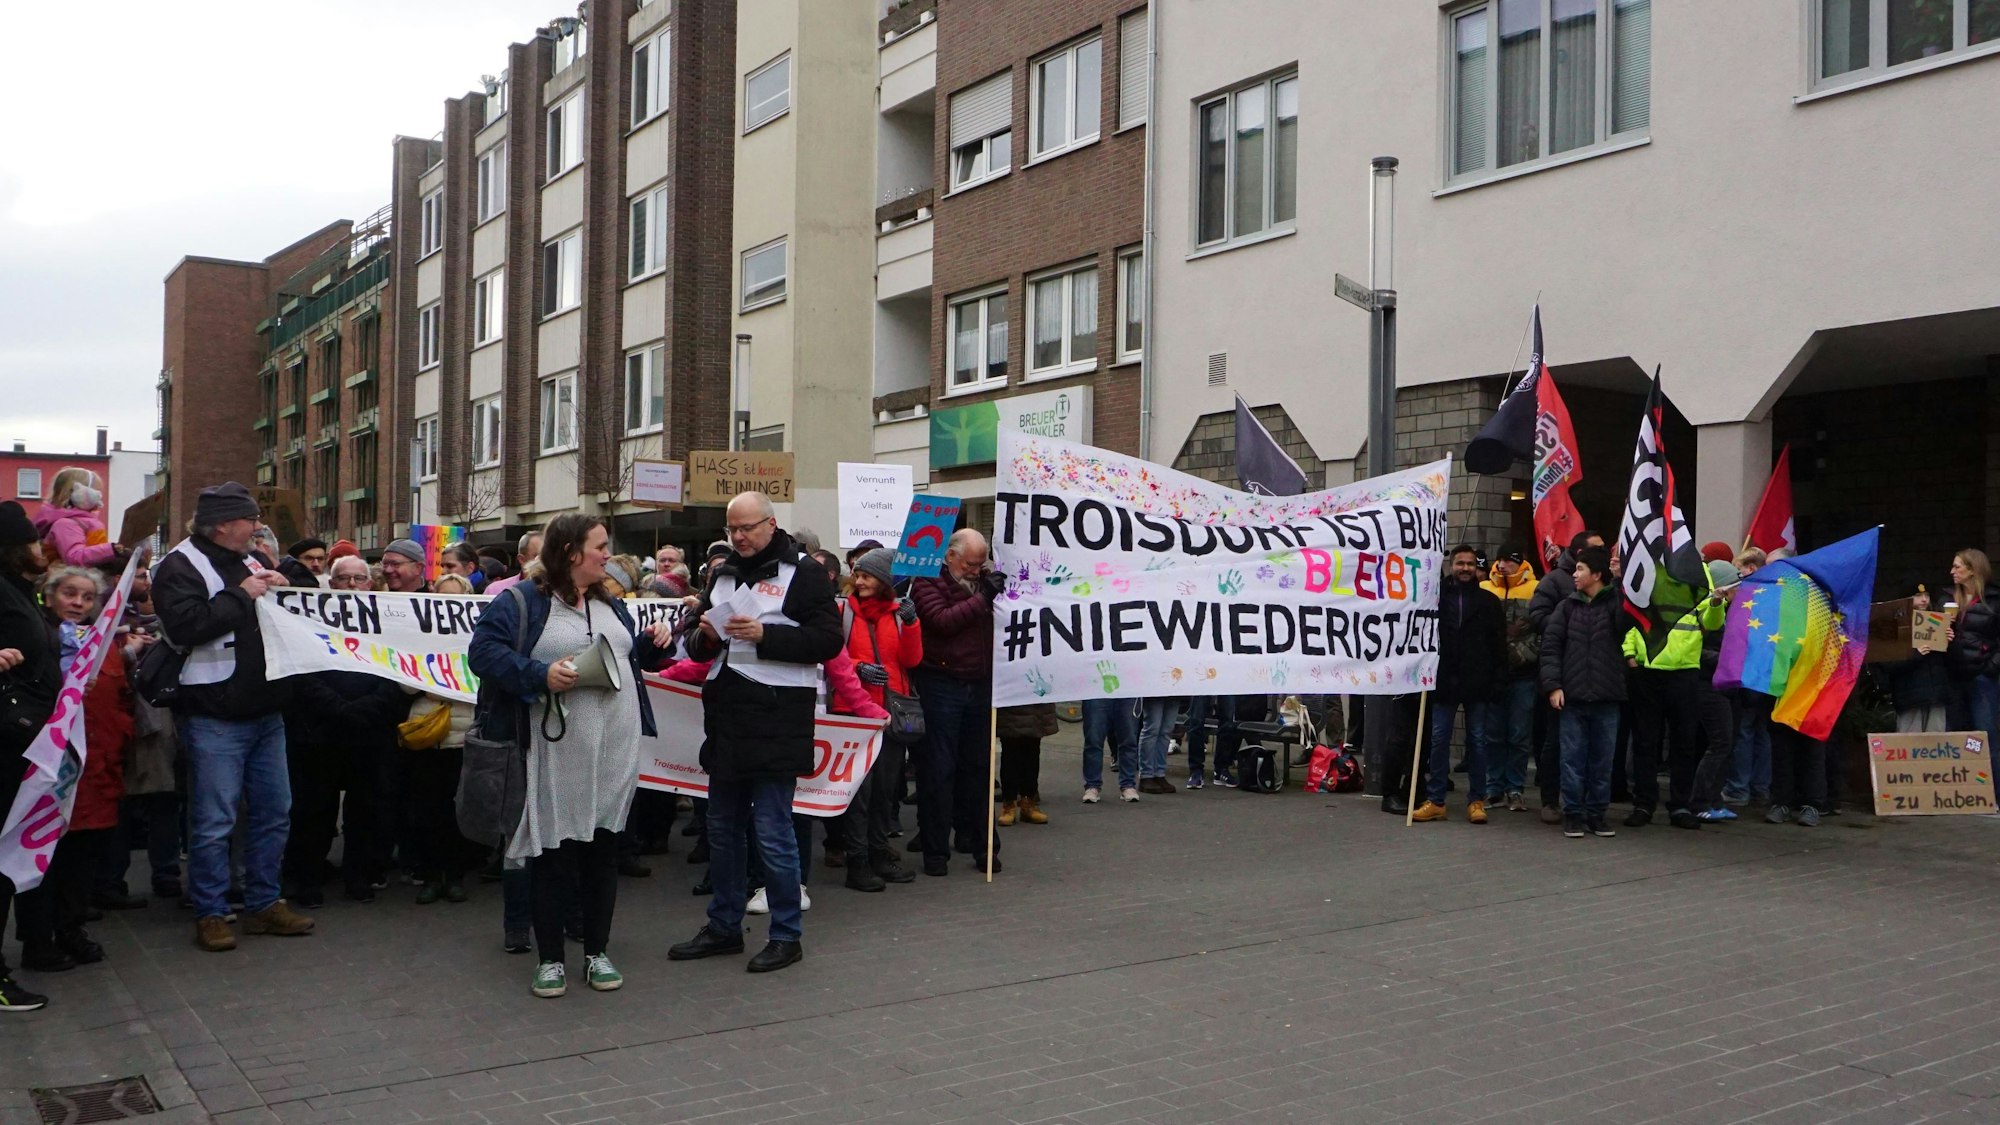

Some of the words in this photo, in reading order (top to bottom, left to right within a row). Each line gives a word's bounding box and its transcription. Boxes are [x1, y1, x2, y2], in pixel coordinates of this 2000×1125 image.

[1019, 409, 1056, 428] BREUER
[696, 456, 739, 475] HASS
[743, 462, 756, 475] ist
[855, 475, 896, 485] Vernunft
[860, 501, 894, 510] Vielfalt
[911, 501, 959, 518] Gegen
[849, 528, 902, 538] Miteinande
[996, 491, 1315, 557] TROISDORF
[1318, 509, 1386, 551] IST
[894, 552, 942, 567] Nazis
[1300, 547, 1422, 602] BLEIBT
[276, 590, 382, 635] GEGEN
[383, 604, 407, 618] das
[410, 598, 489, 635] VERG
[1885, 748, 1908, 761] zu
[1912, 741, 1961, 759] rechts
[654, 758, 699, 774] Troisdorfer
[1886, 773, 1914, 784] um
[1922, 766, 1970, 784] recht
[1893, 796, 1919, 809] zu
[1933, 790, 1994, 809] haben.
